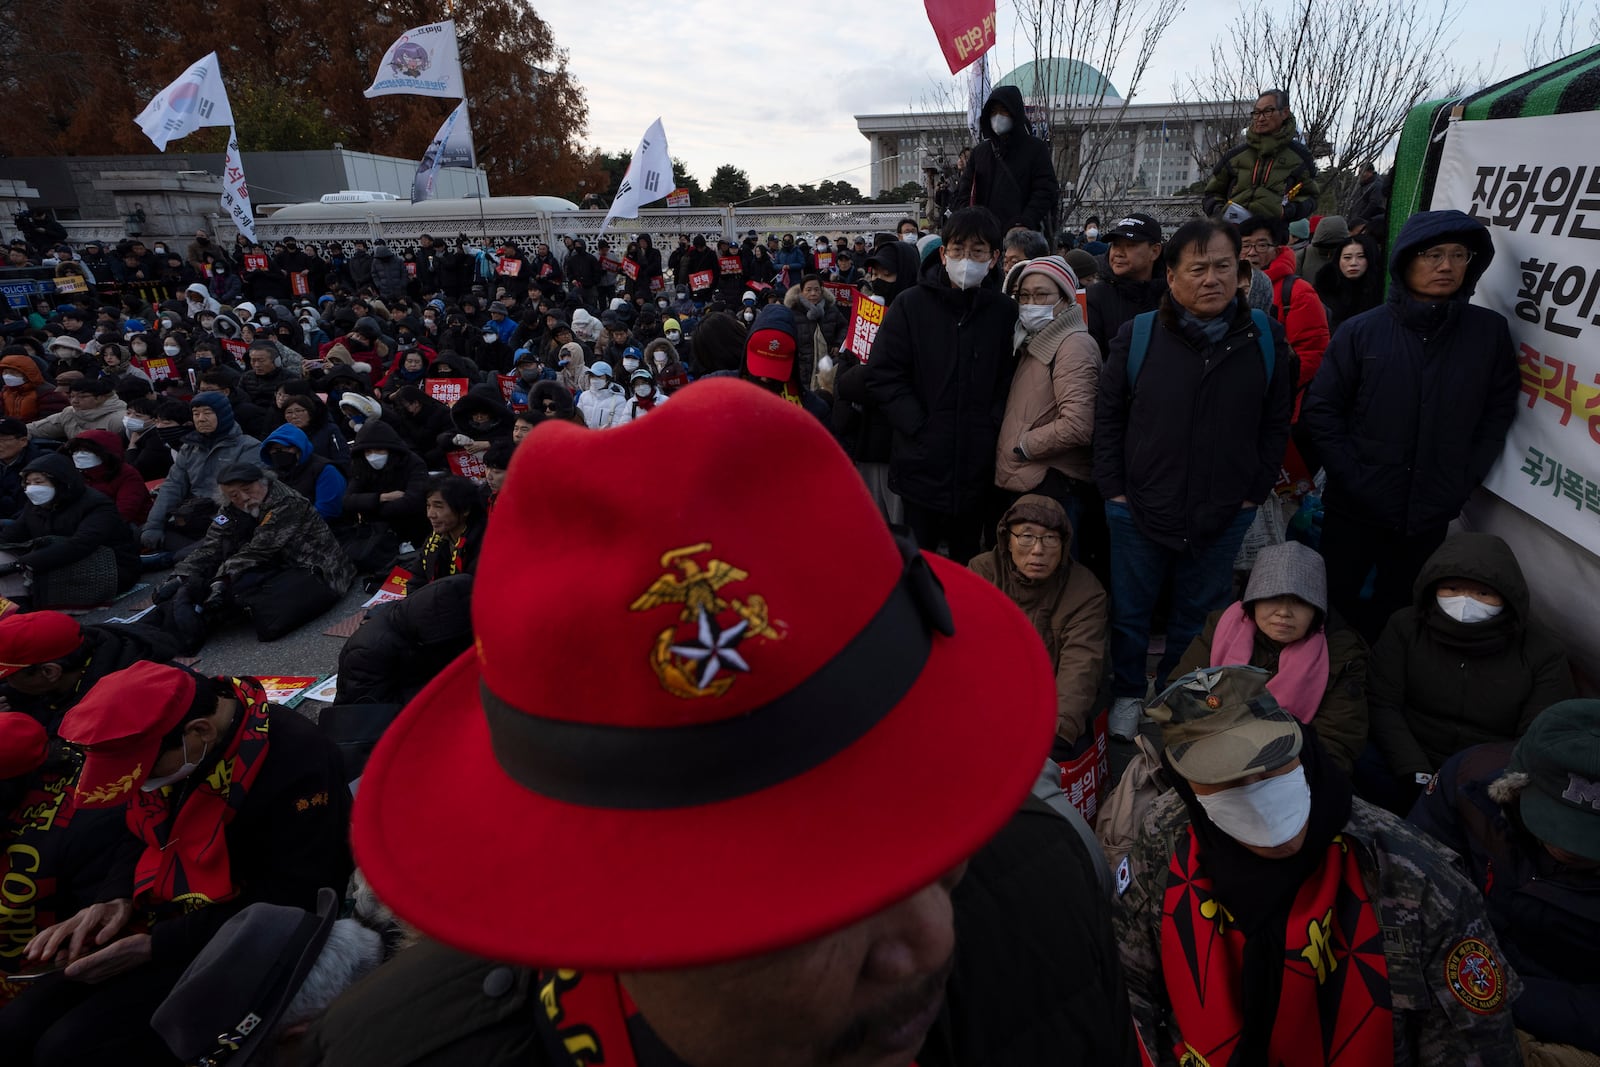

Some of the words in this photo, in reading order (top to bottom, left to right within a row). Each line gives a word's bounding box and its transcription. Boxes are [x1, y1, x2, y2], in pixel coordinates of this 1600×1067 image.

[1514, 257, 1600, 339] 황인
[854, 315, 880, 344] 윤석열
[852, 333, 872, 361] 탄핵!
[432, 383, 461, 393] 윤석열을
[1518, 341, 1579, 427] 즉각
